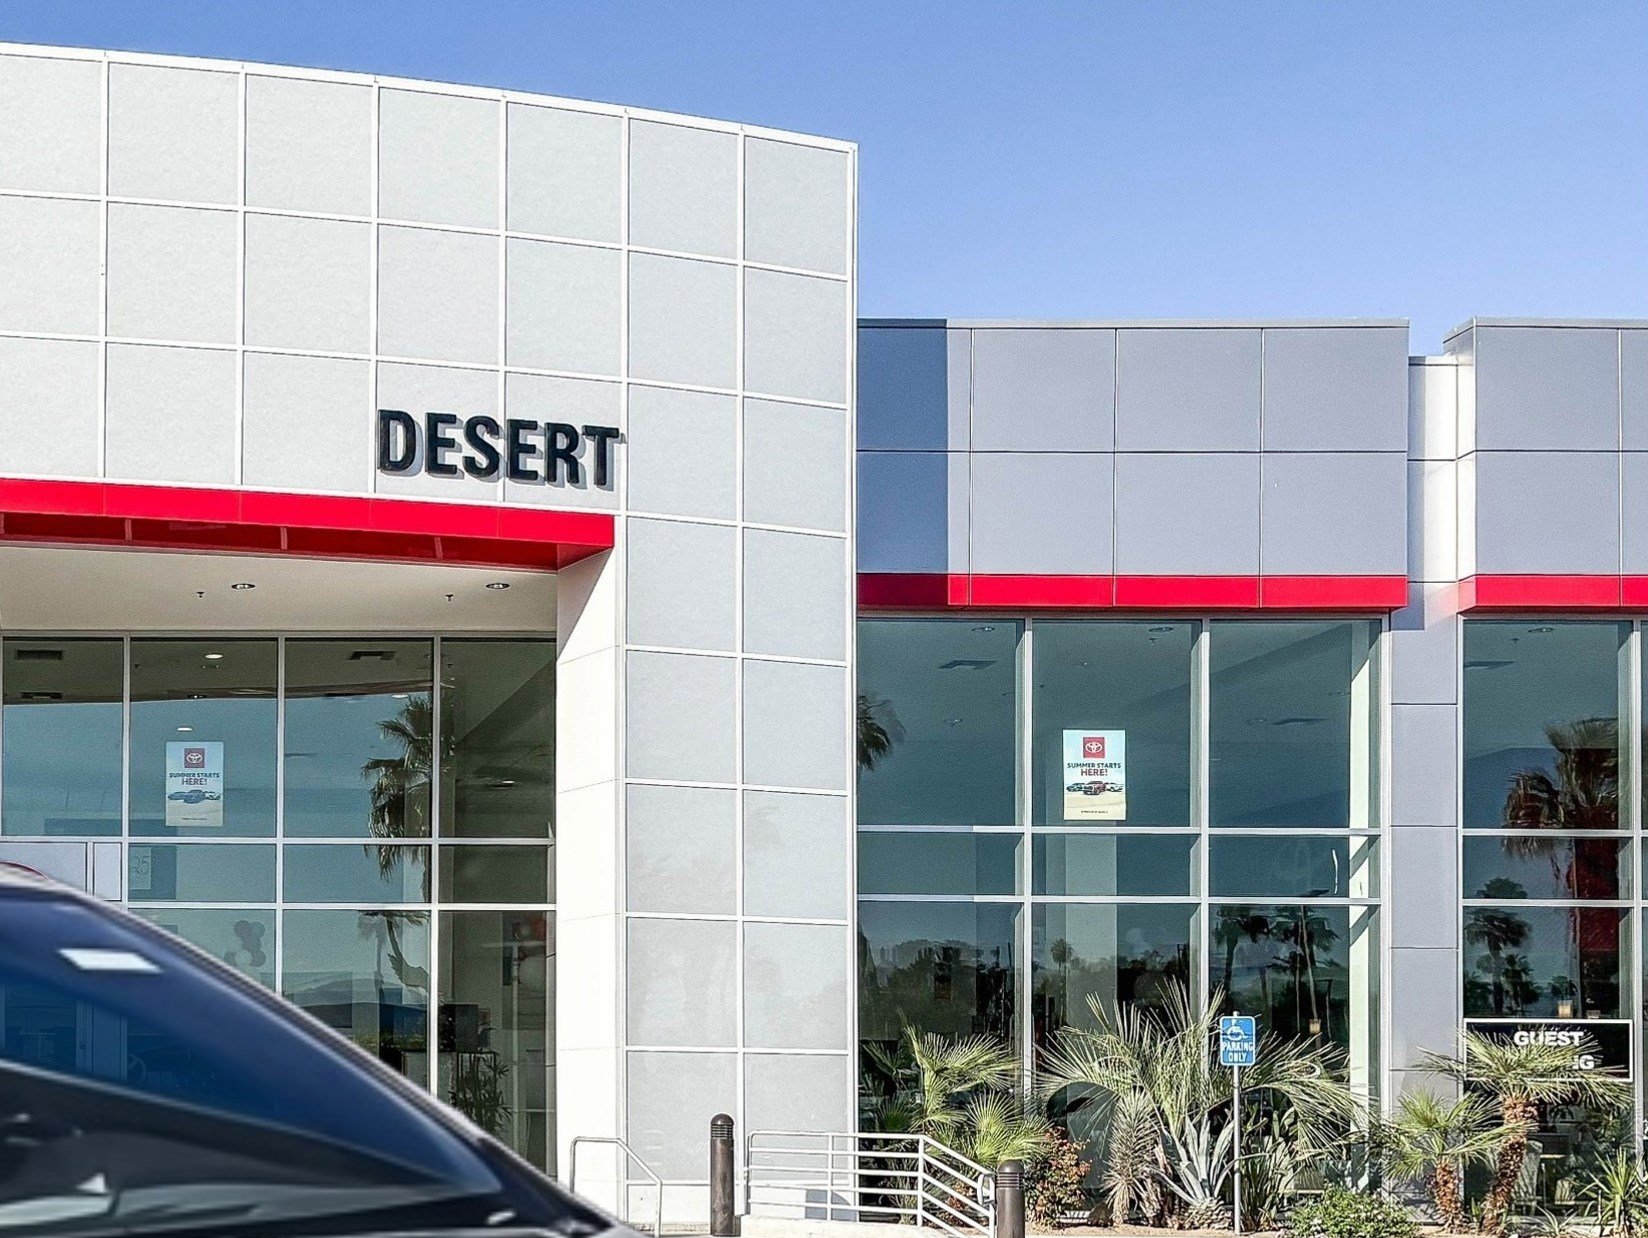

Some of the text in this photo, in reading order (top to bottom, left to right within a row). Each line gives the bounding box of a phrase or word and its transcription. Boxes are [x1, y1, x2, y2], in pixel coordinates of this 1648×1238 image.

[376, 409, 621, 487] DESERT
[1080, 768, 1108, 777] HERE!
[181, 778, 208, 786] HERE!
[1513, 1030, 1585, 1047] GUEST
[1221, 1041, 1254, 1052] PARKING
[1228, 1051, 1248, 1063] ONLY
